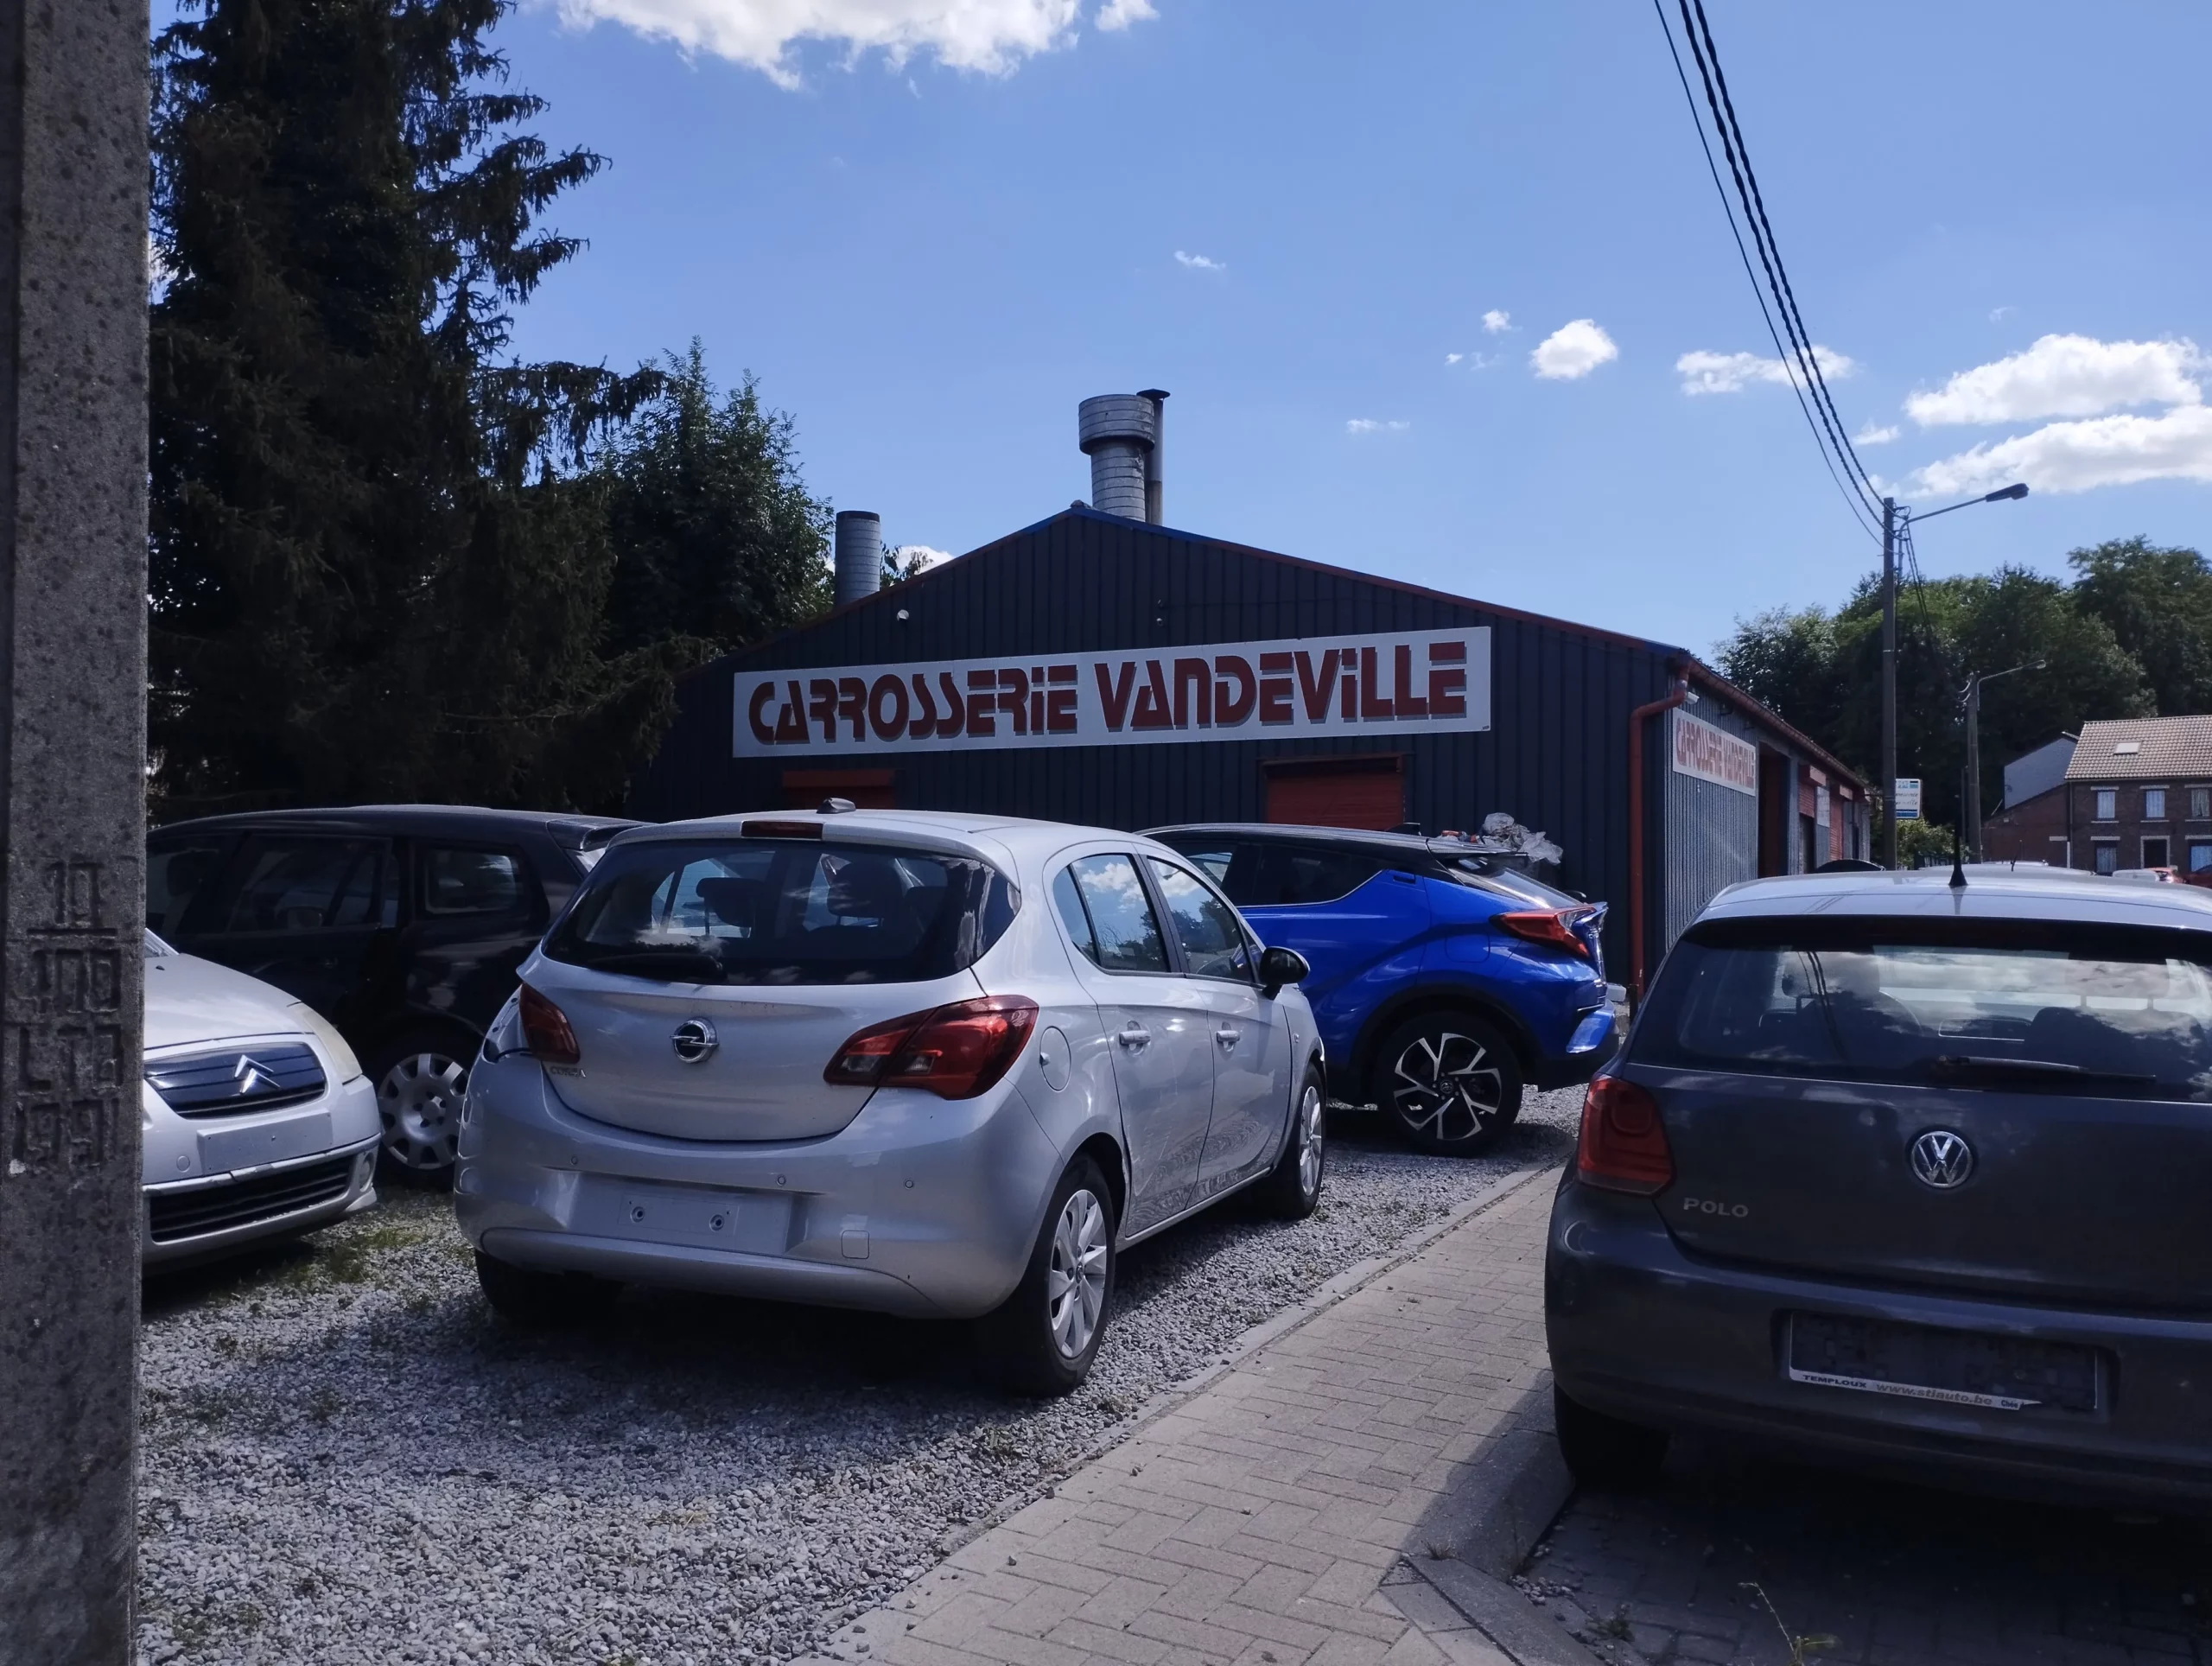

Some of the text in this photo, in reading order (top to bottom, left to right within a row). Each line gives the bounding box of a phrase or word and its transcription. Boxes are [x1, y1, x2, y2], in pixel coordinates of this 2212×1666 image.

[748, 641, 1467, 745] CARROSSERIE VANDEVILLE
[1683, 1198, 1749, 1218] POLO
[1802, 1374, 1867, 1389] TEMPLOUX
